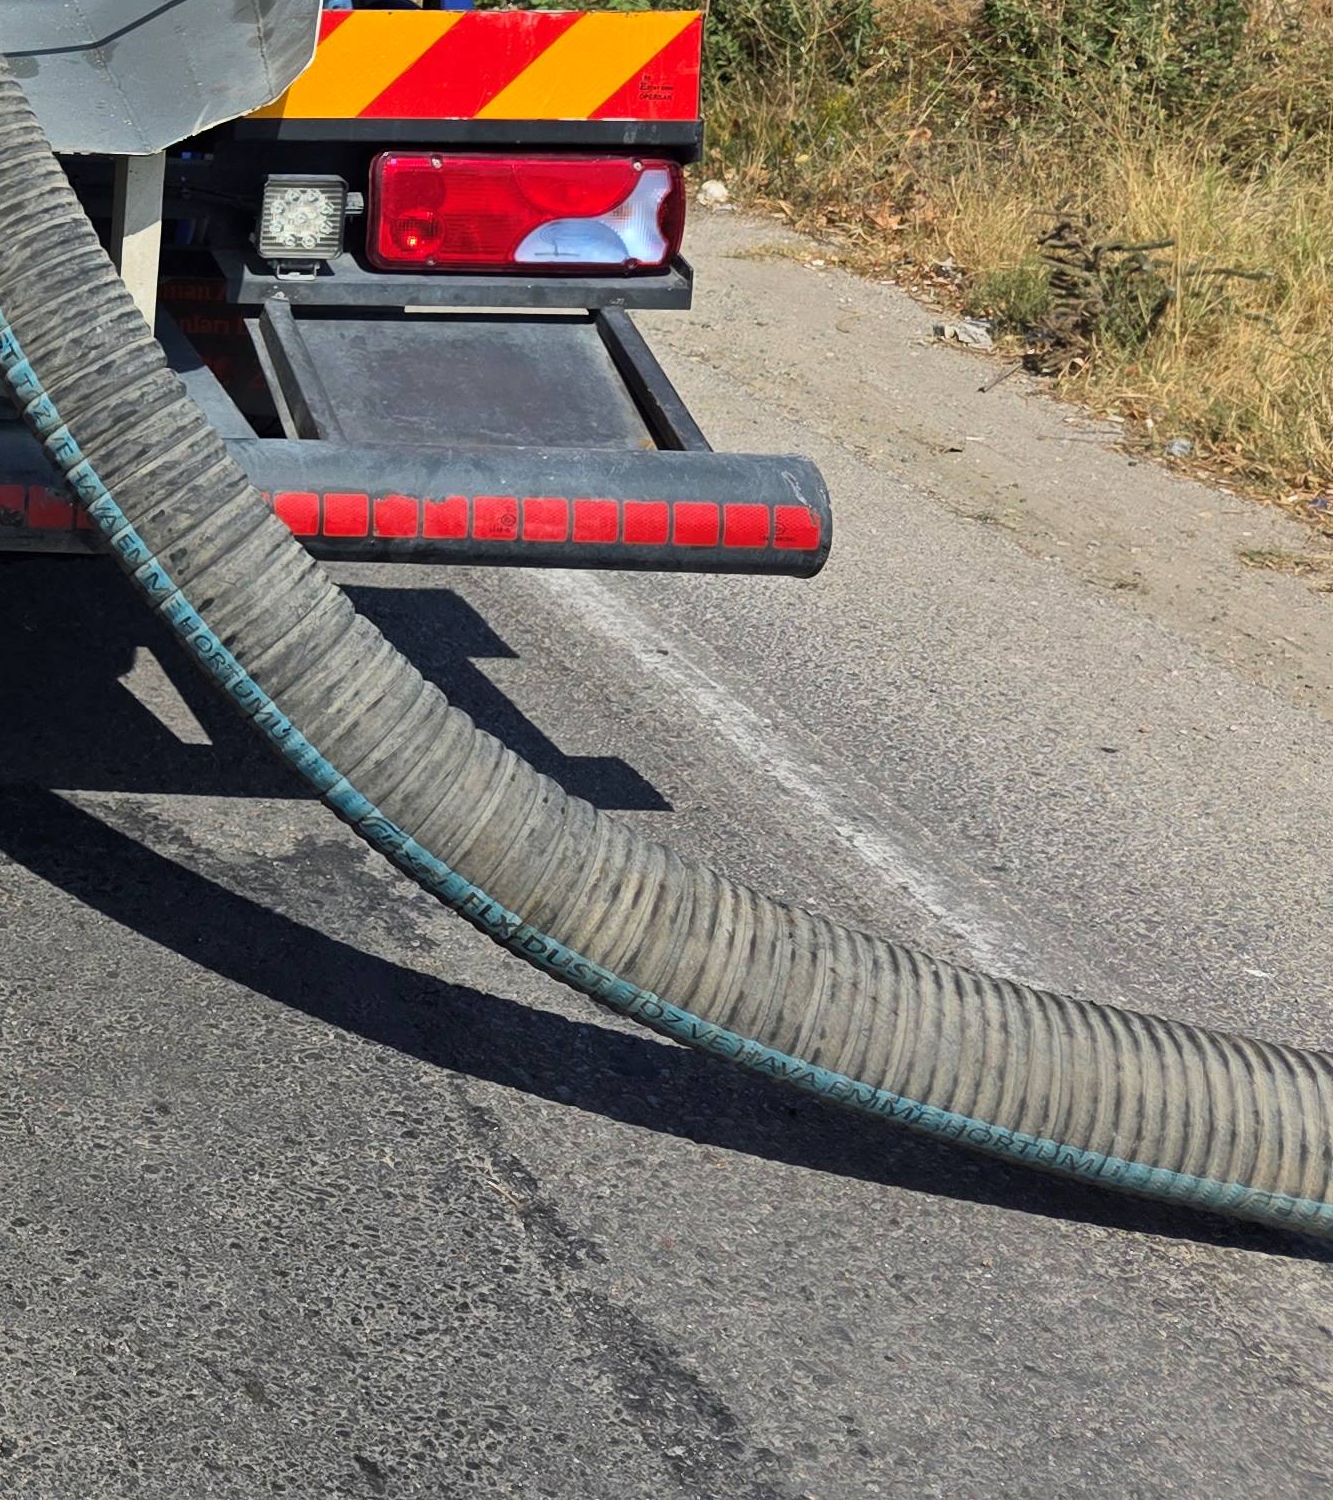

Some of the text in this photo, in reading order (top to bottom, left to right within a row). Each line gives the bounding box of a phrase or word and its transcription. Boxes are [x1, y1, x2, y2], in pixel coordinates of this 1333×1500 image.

[625, 988, 684, 1031] TOZ
[689, 1022, 734, 1049] VE
[735, 1039, 819, 1088] HAVA
